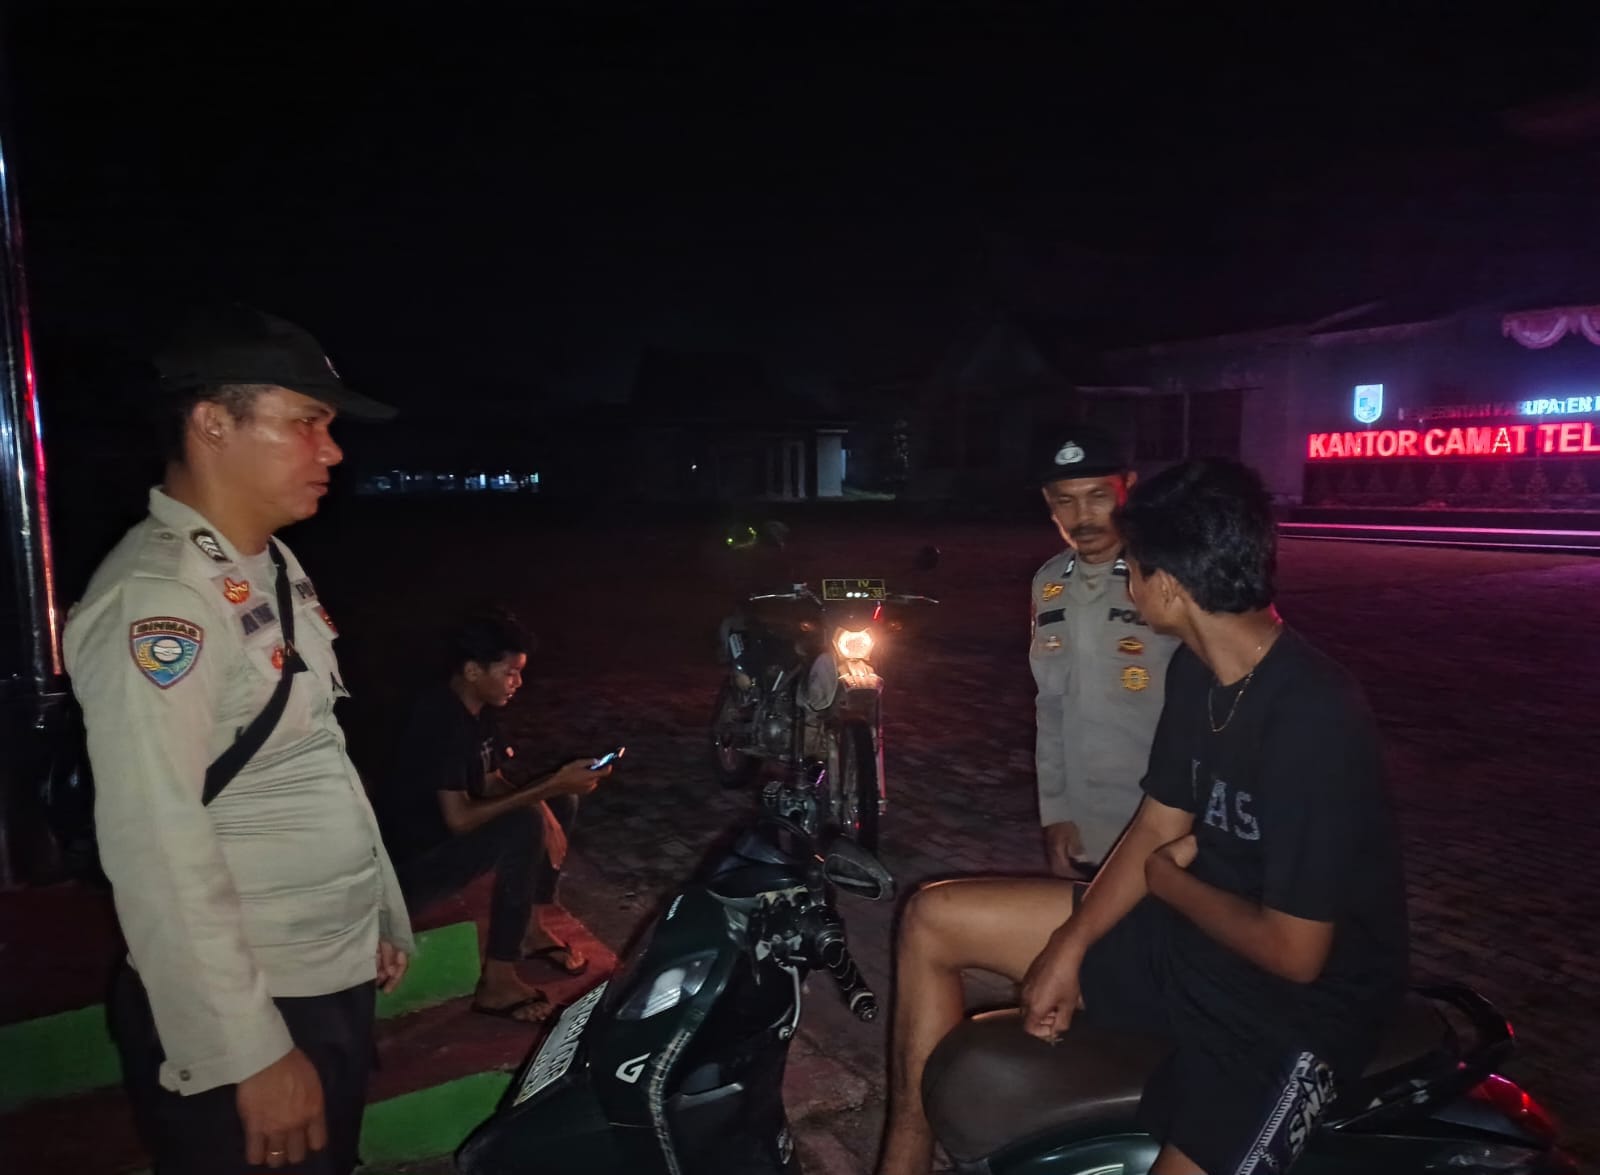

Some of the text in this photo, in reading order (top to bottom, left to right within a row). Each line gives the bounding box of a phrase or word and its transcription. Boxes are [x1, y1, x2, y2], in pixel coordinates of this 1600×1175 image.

[1510, 396, 1593, 416] UPATEN
[1308, 422, 1600, 458] KANTOR CAMAT TEL
[1108, 607, 1149, 626] POL
